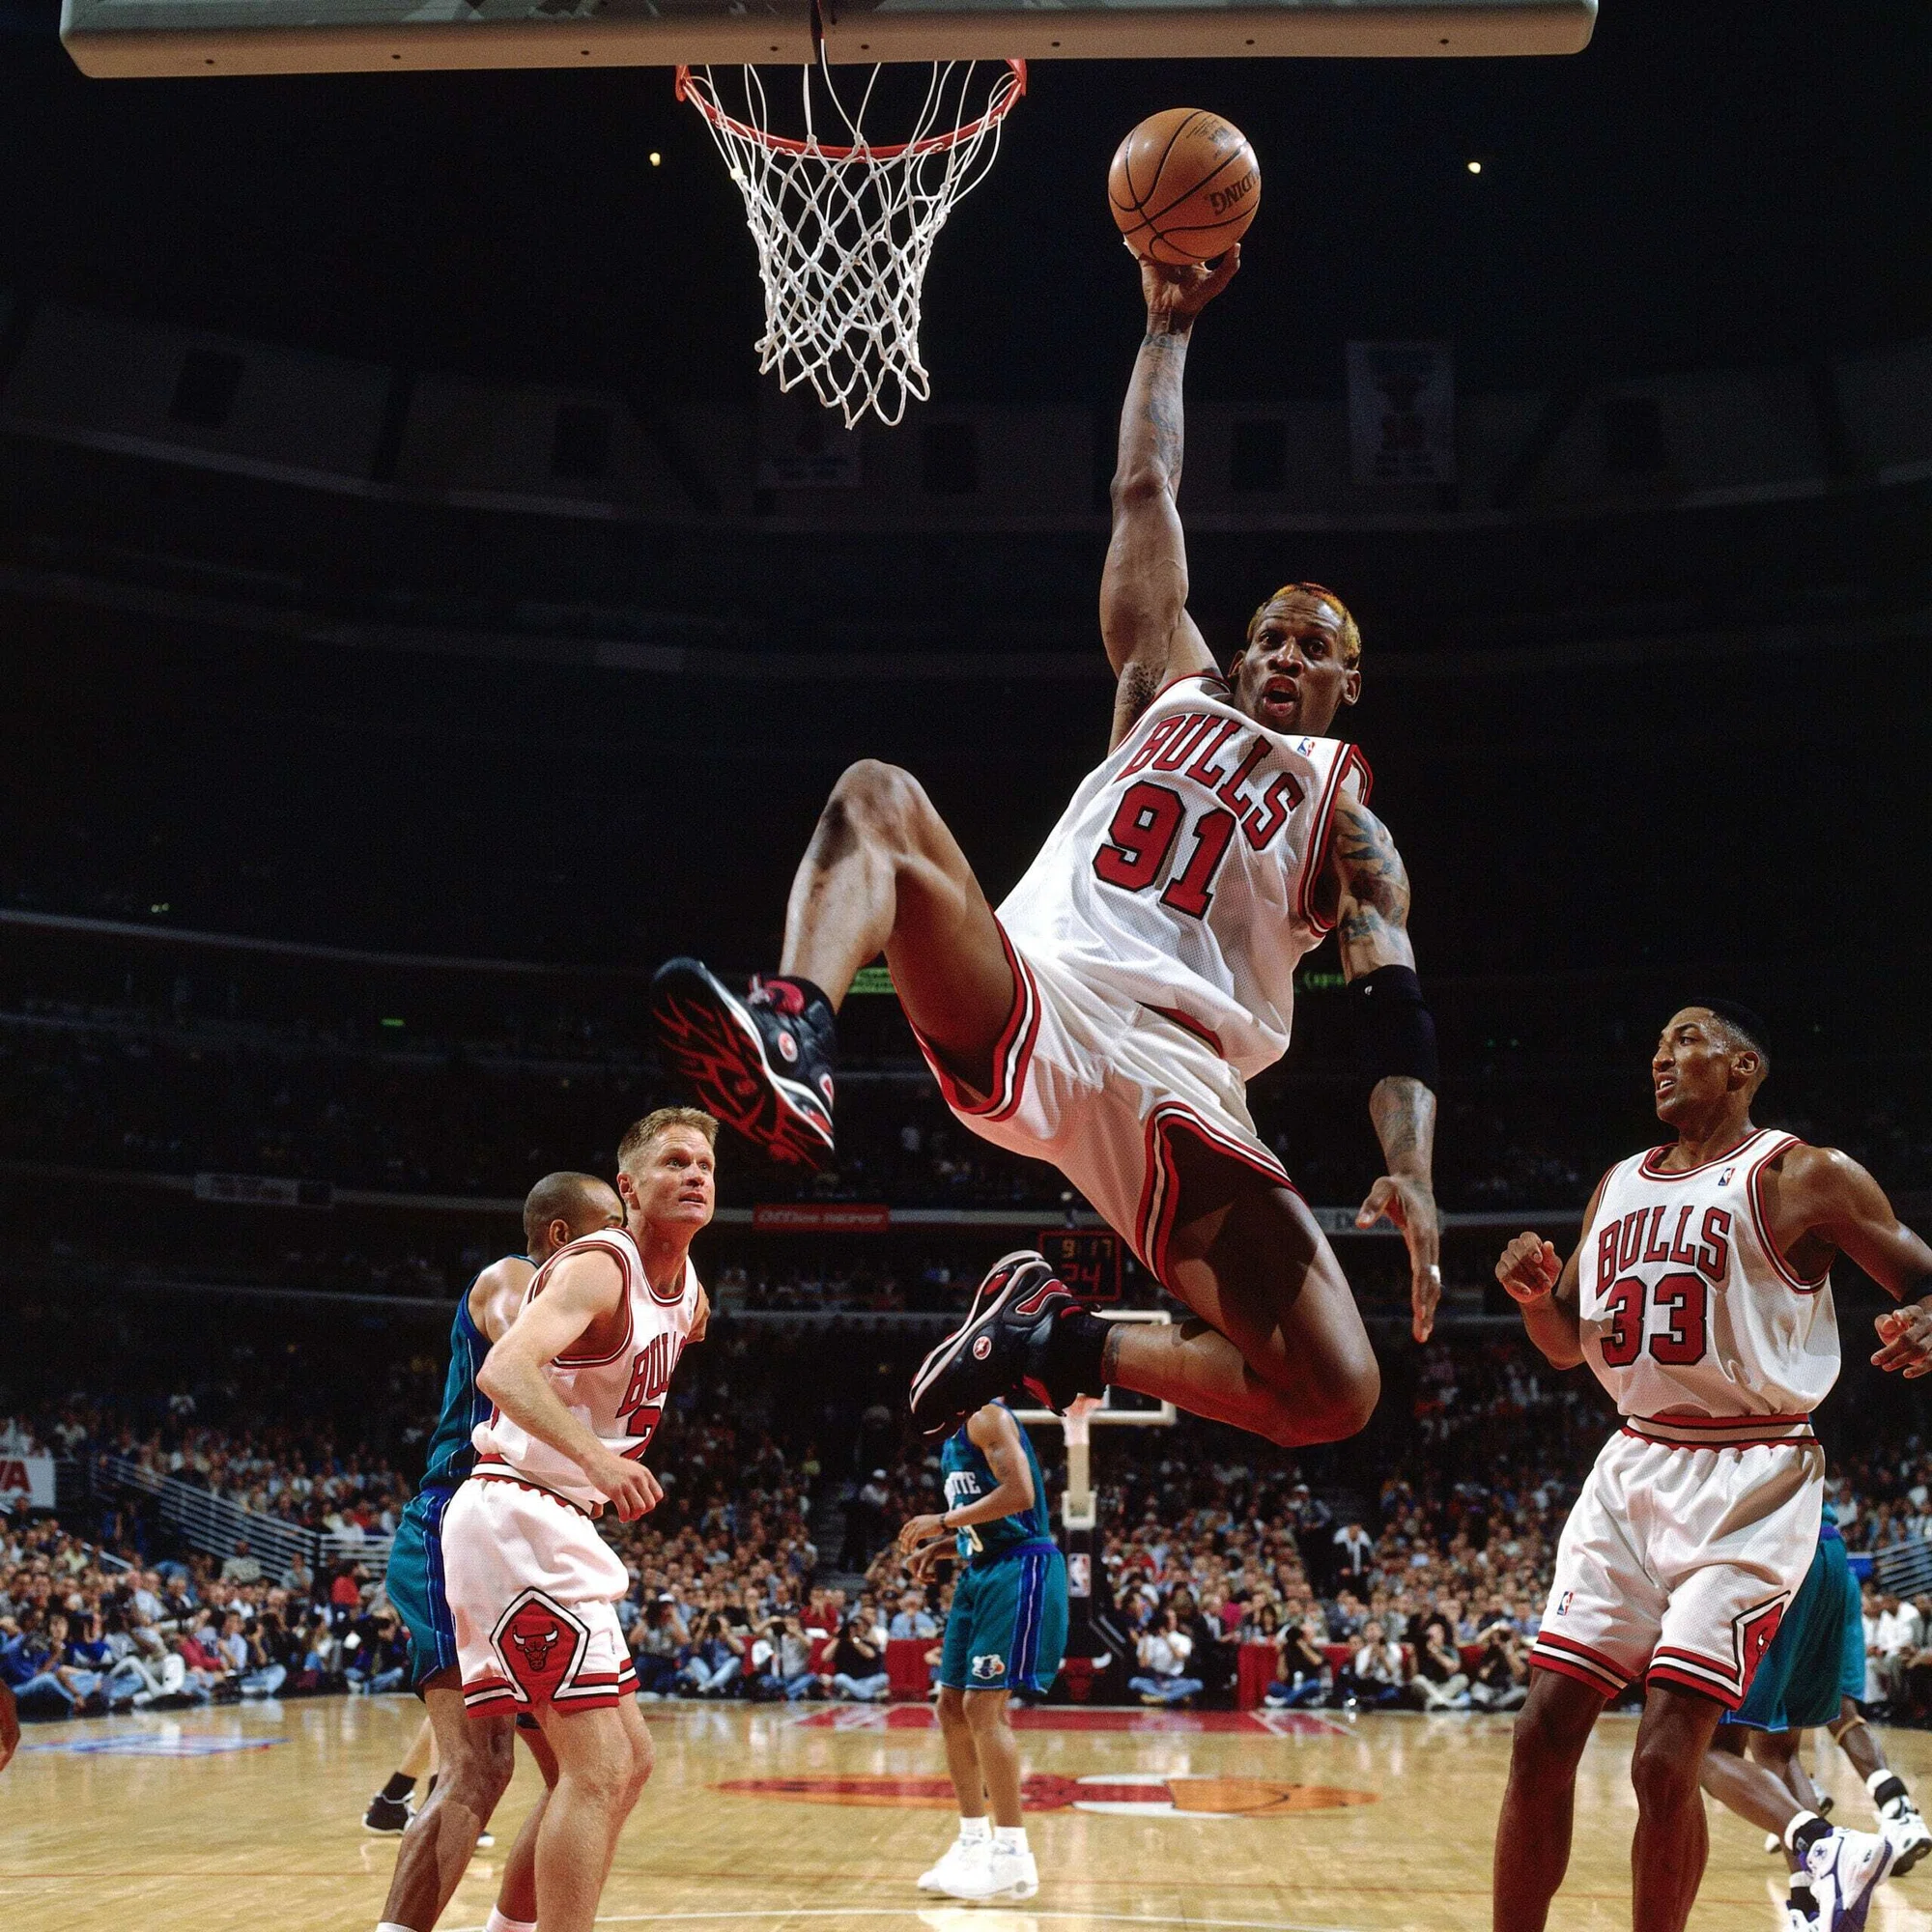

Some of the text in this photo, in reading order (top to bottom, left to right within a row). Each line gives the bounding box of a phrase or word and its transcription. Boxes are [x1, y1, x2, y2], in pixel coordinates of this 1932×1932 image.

[1113, 713, 1305, 851] BULLS
[1092, 780, 1236, 921] 91
[1596, 1206, 1732, 1300] BULLS
[1600, 1272, 1708, 1368] 33
[615, 1331, 687, 1418] BUL
